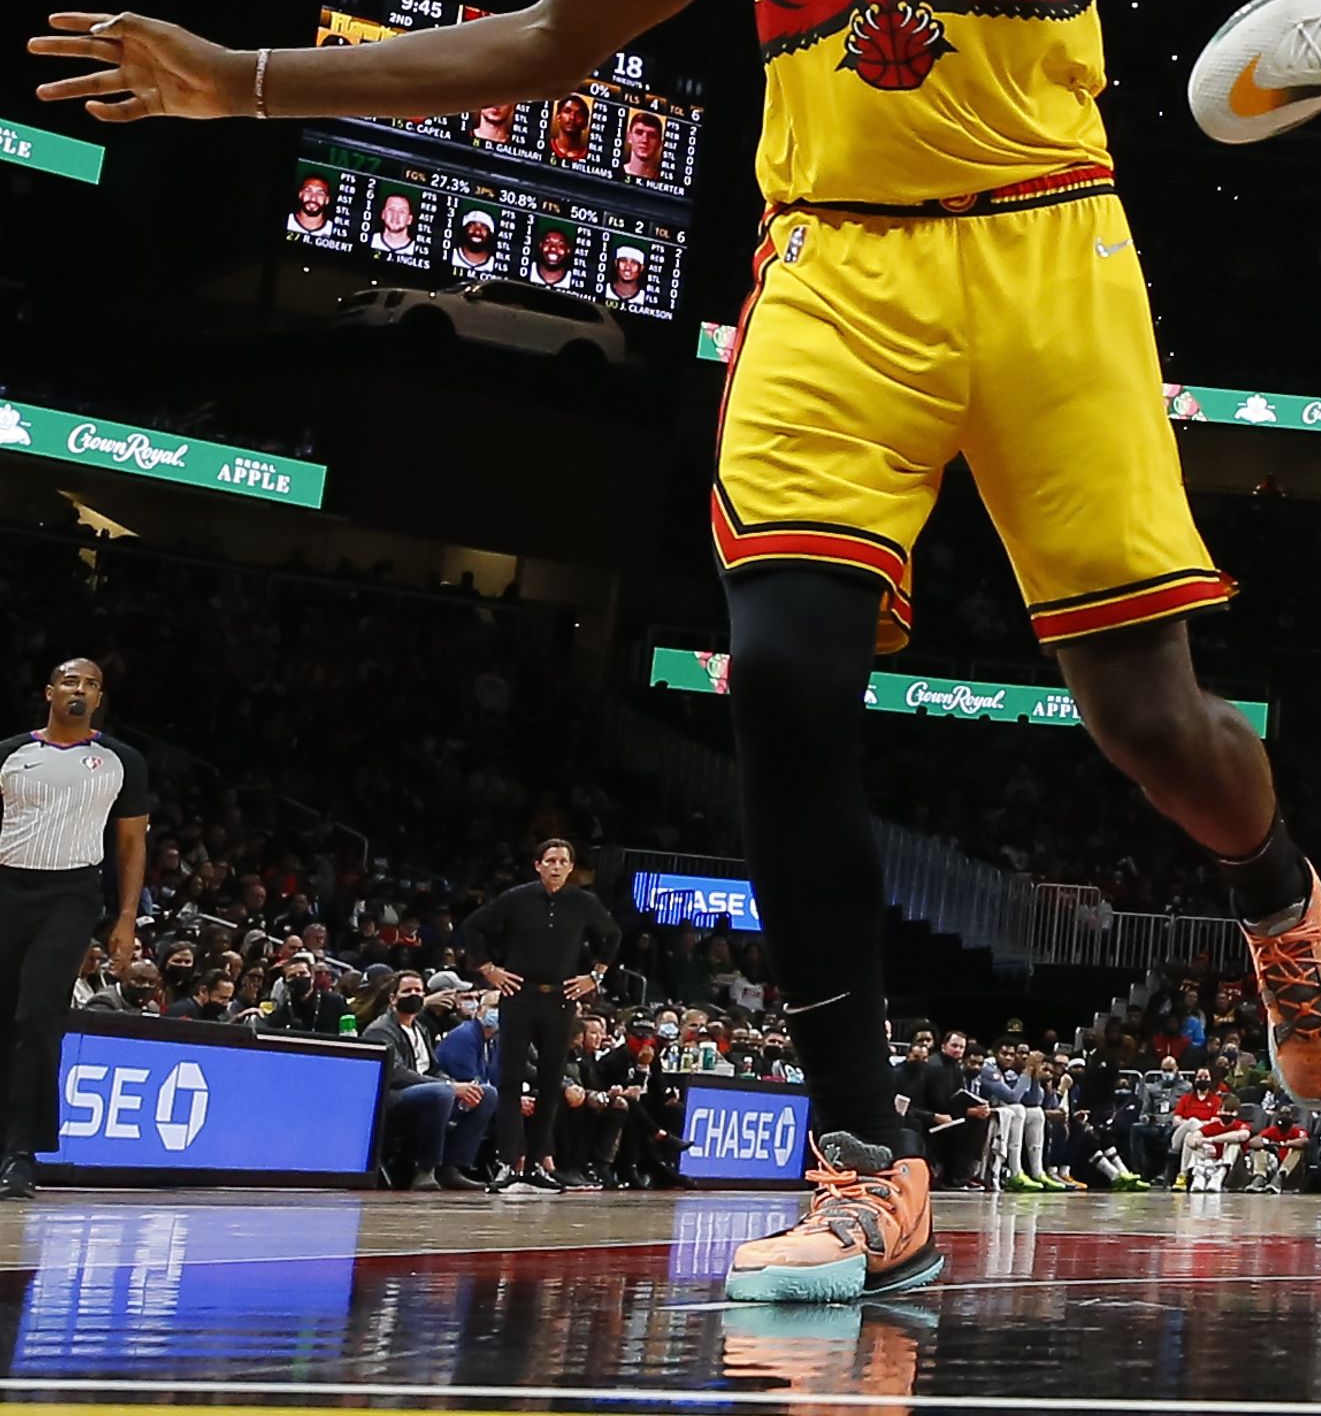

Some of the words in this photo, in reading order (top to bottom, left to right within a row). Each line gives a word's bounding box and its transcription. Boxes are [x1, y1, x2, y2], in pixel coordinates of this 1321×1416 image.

[389, 12, 413, 27] 2ND
[614, 52, 643, 78] 18
[650, 99, 658, 110] 4
[691, 109, 700, 121] 6
[417, 124, 451, 140] CAPELA
[431, 174, 471, 194] 27.3%
[499, 190, 538, 210] 30.8%
[570, 205, 599, 223] 50%
[635, 221, 645, 234] 2
[676, 231, 686, 244] 6
[216, 463, 292, 495] APPLE
[1032, 701, 1081, 718] APPL
[688, 1108, 774, 1160] CHASE
